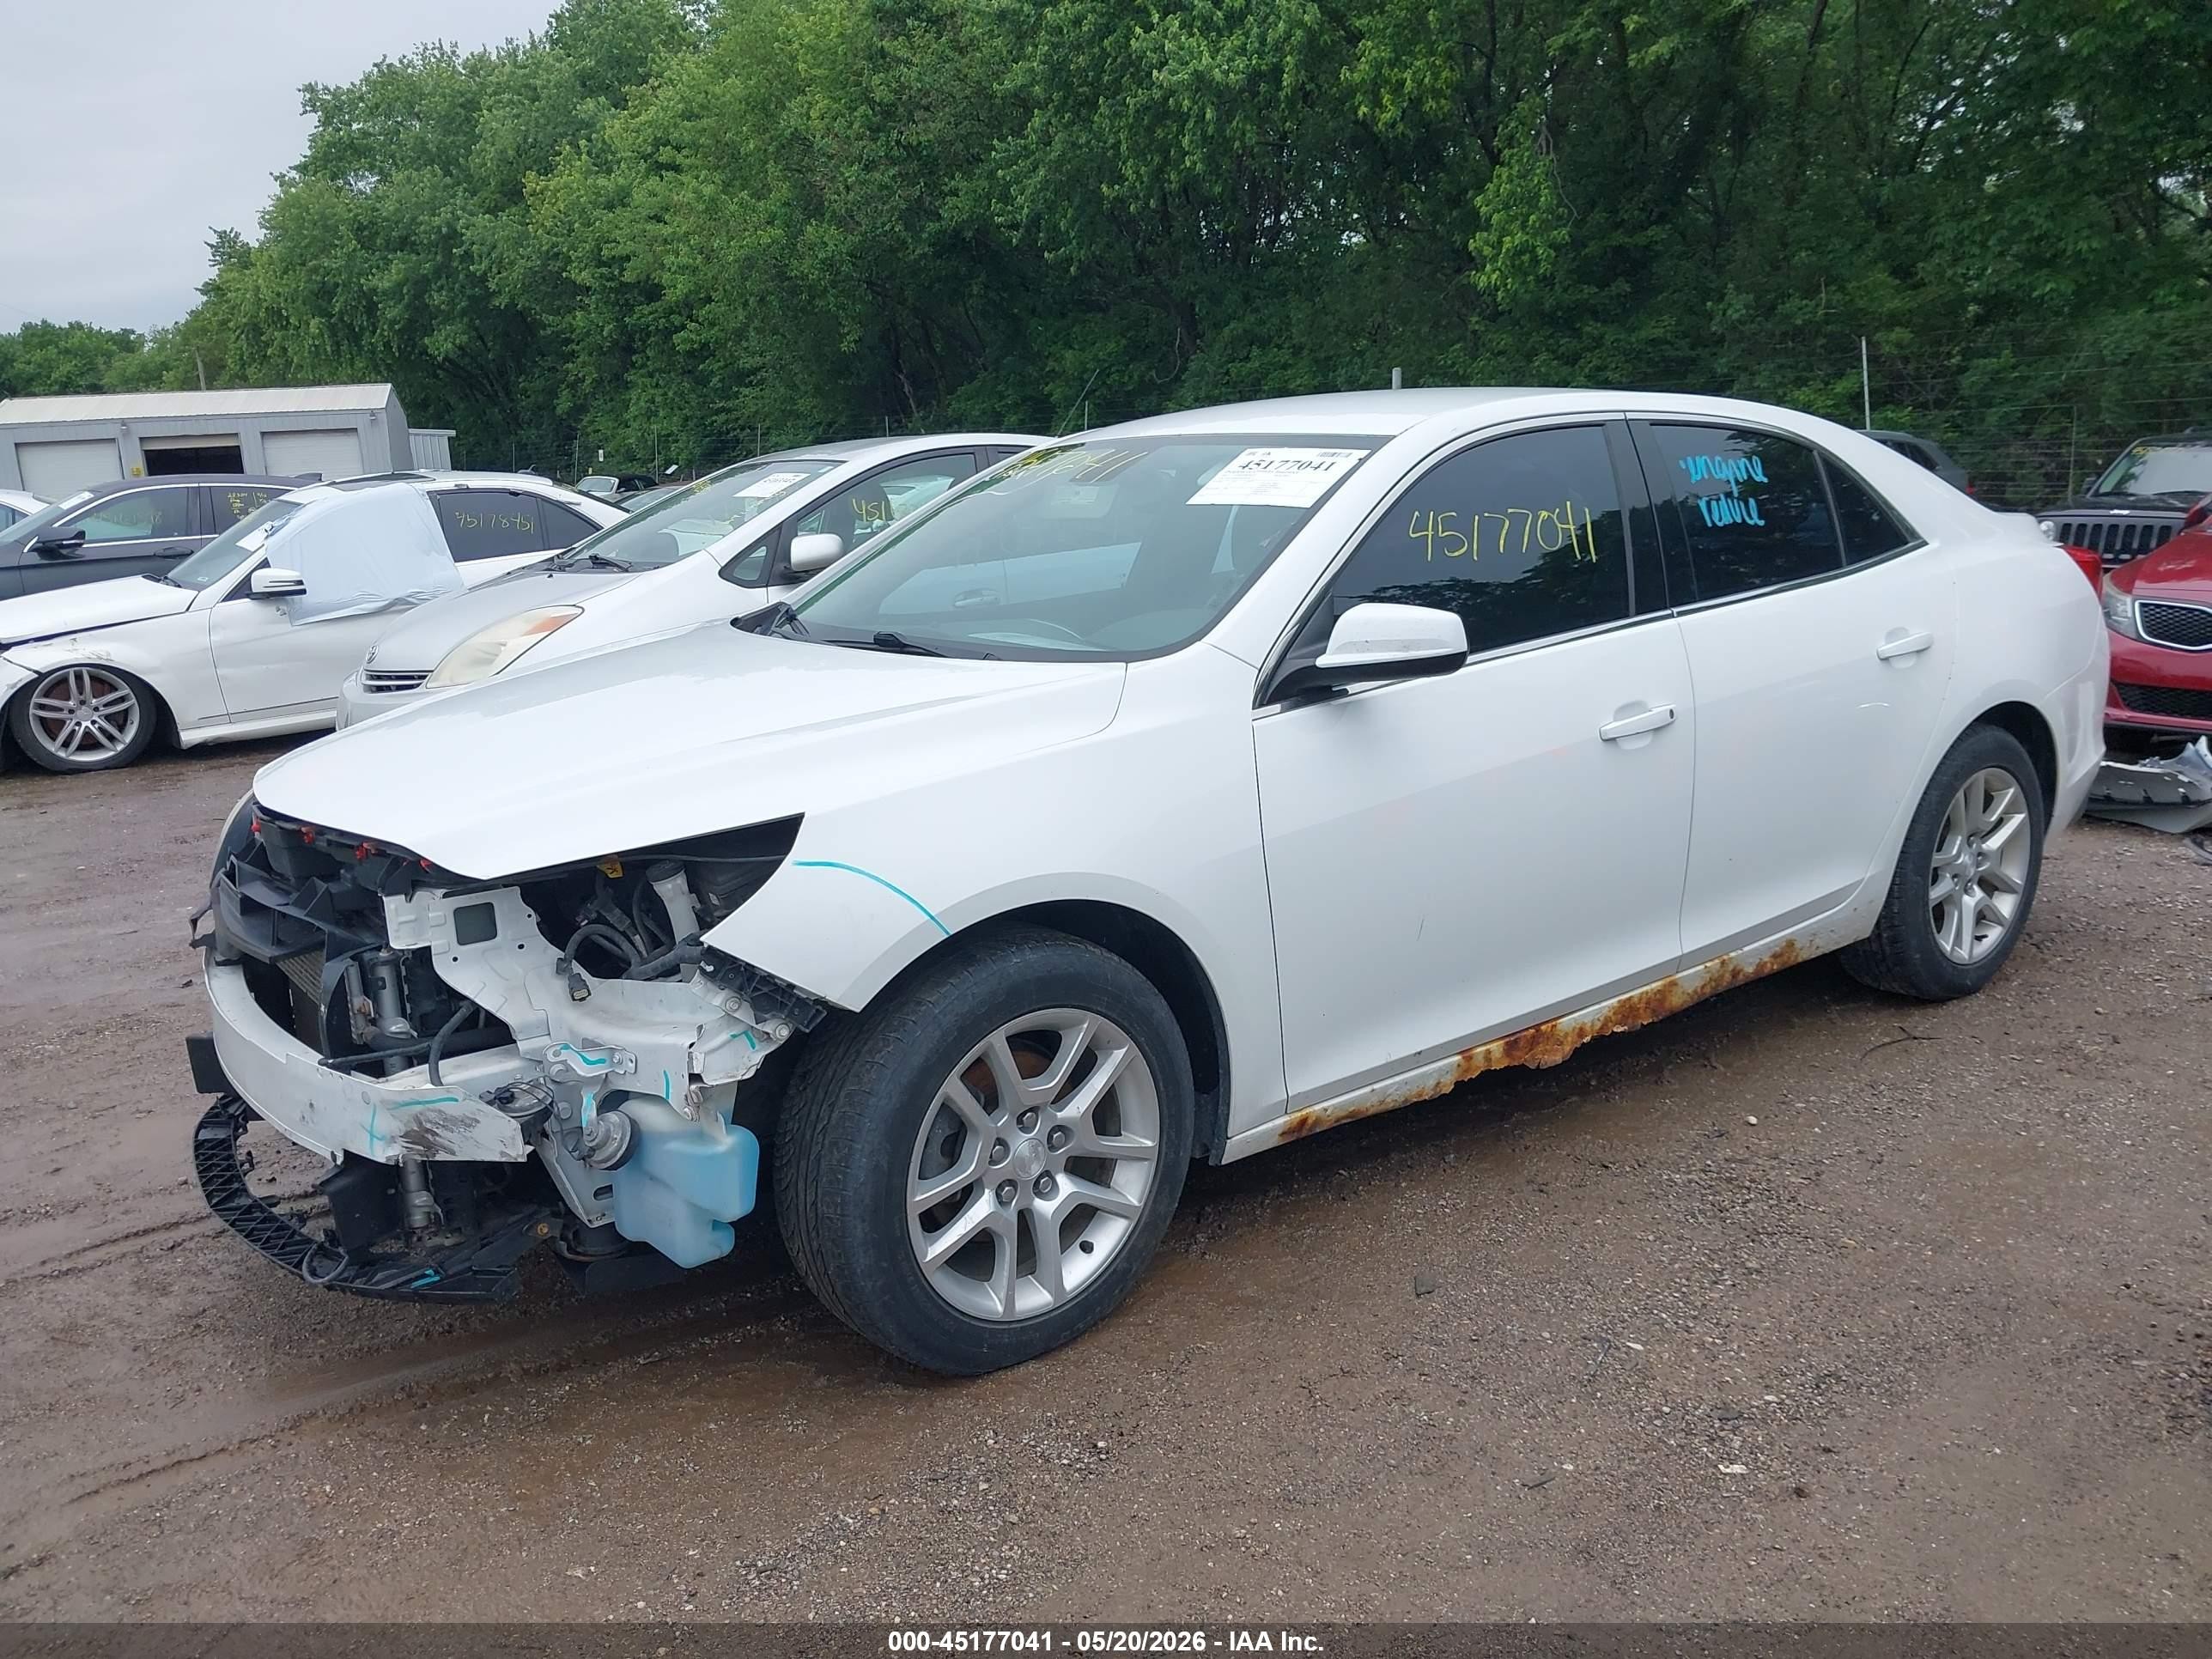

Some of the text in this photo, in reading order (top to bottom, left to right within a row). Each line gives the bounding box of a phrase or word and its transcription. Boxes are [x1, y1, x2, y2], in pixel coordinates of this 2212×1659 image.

[1238, 459, 1338, 471] 45177041
[852, 498, 885, 522] 451
[455, 512, 533, 534] 45178451
[1409, 501, 1597, 562] 45177041
